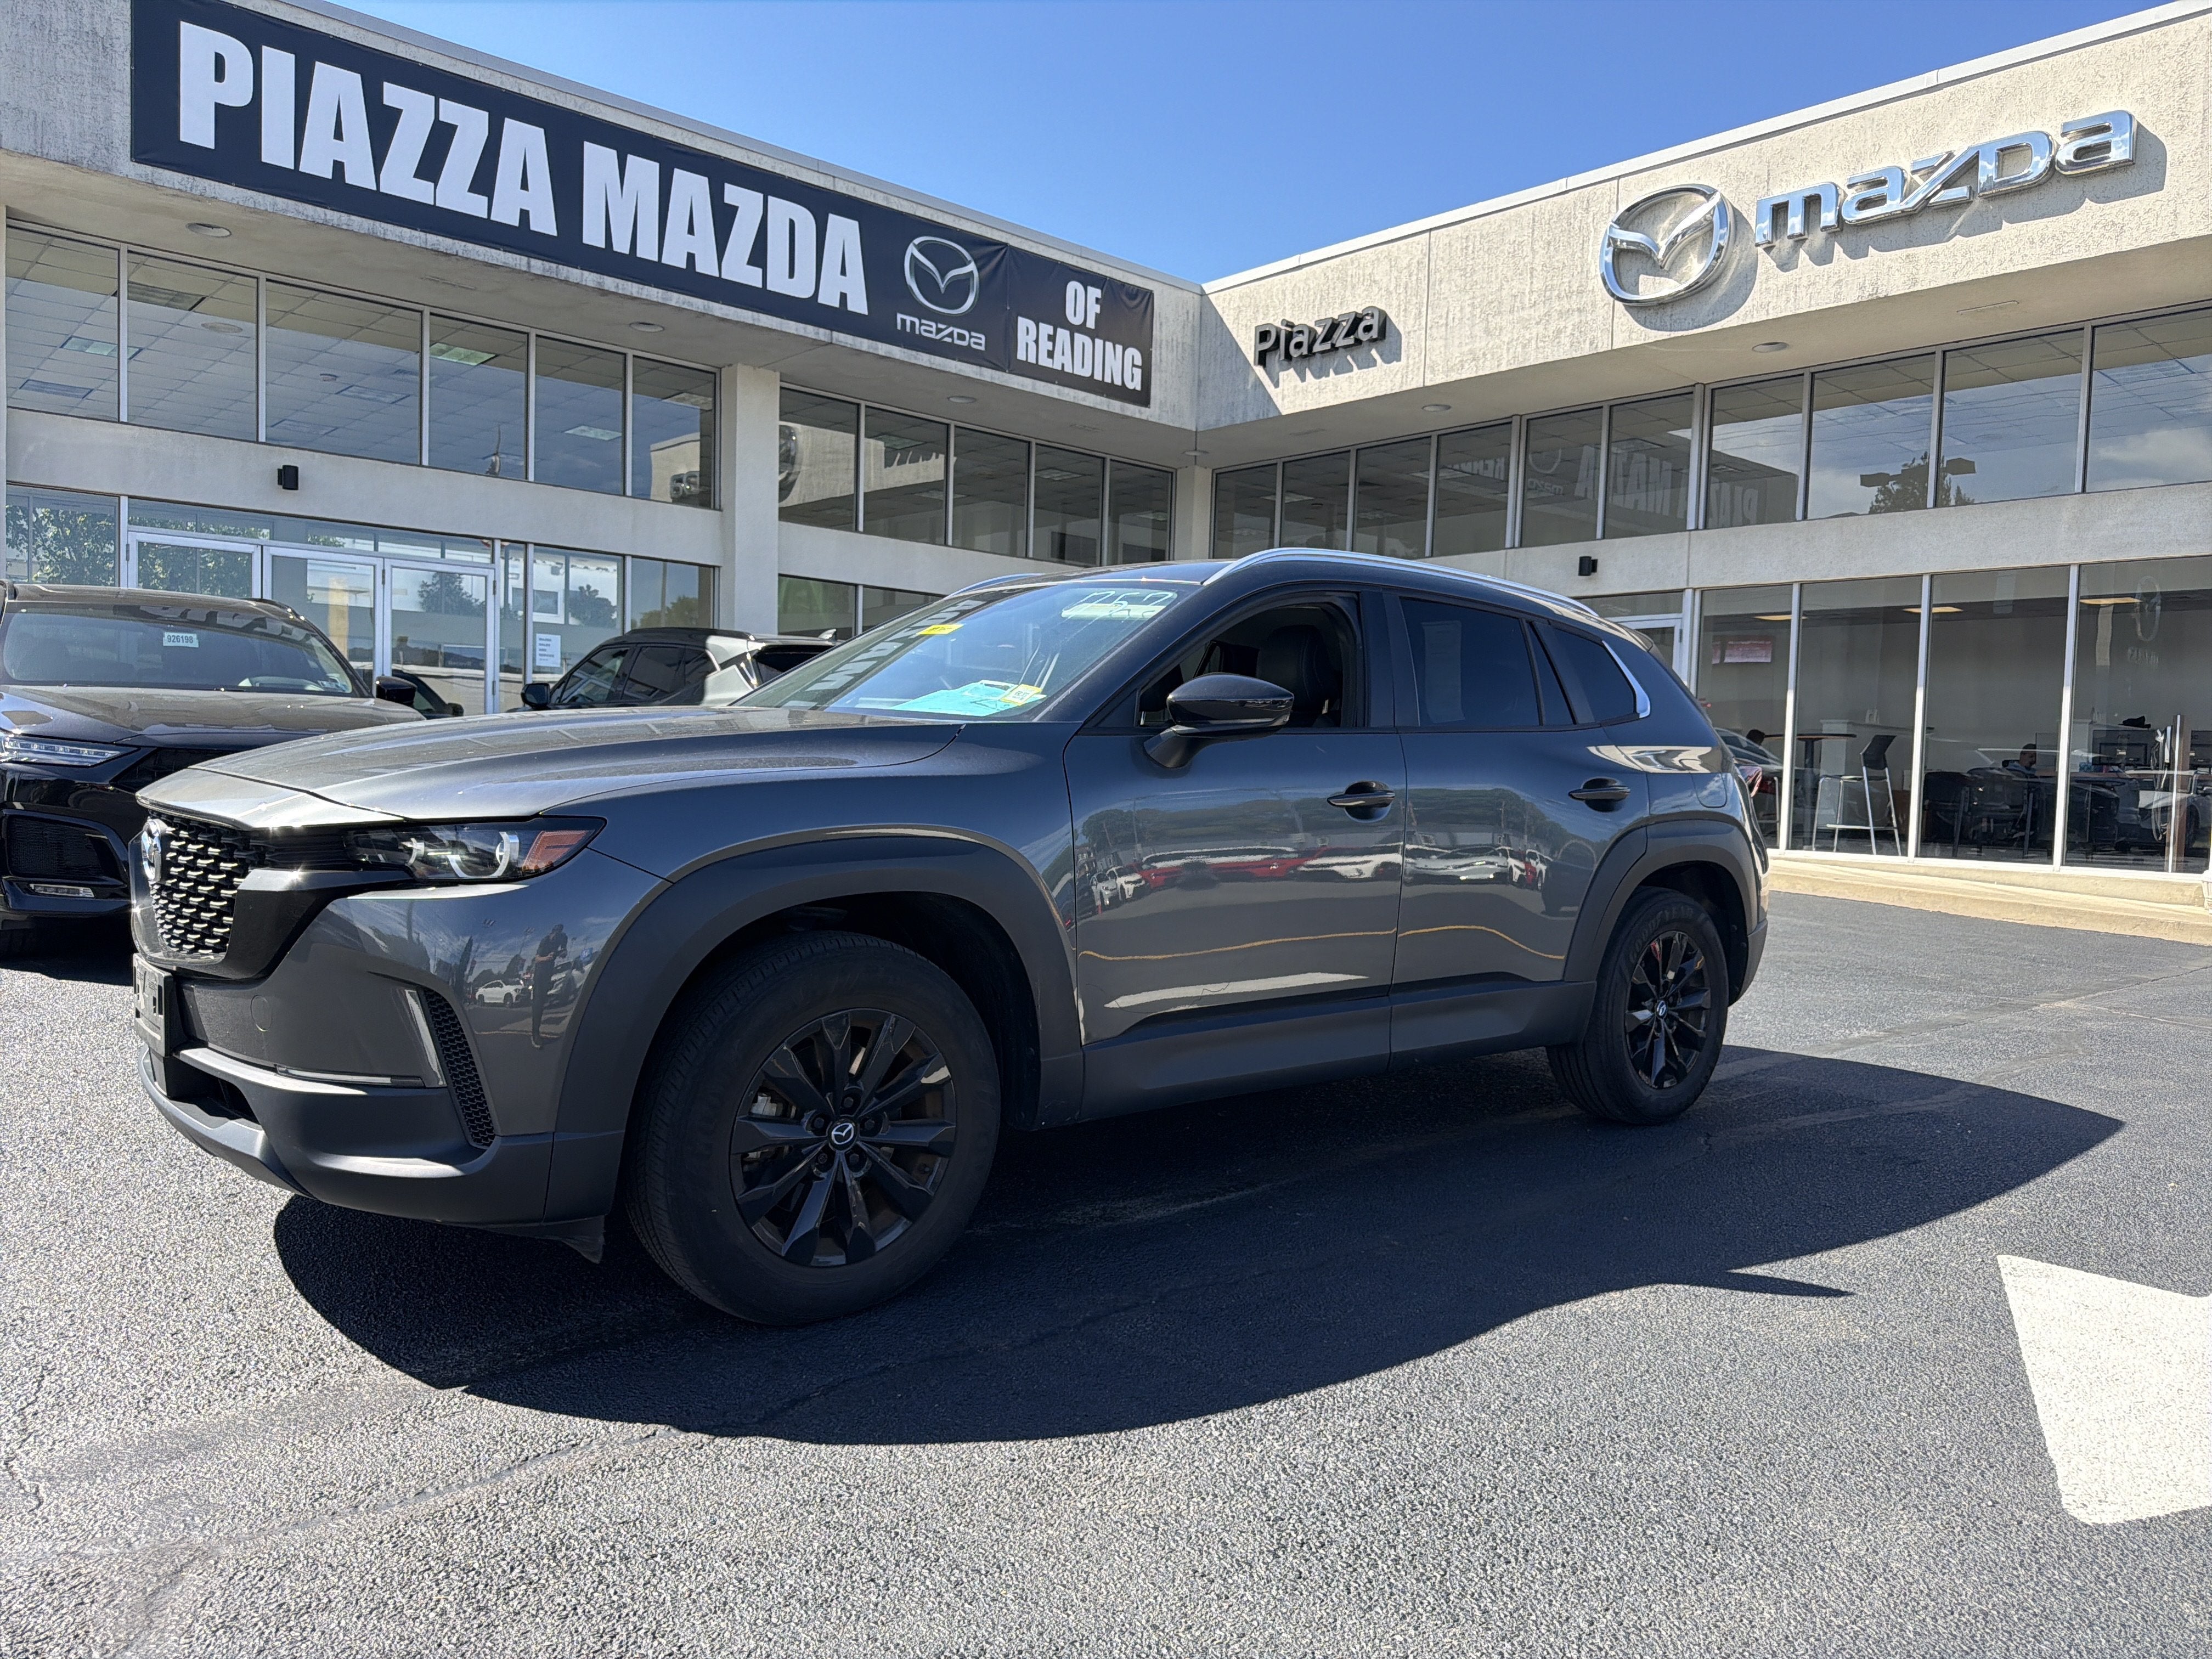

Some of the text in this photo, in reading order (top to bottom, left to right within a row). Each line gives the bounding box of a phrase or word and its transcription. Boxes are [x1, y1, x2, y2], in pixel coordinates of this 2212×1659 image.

[180, 20, 868, 315] PIAZZA MAZDA
[1755, 109, 2137, 247] mazda
[896, 312, 986, 351] mazda
[1065, 280, 1102, 329] OF
[1017, 315, 1142, 391] READING
[1253, 306, 1387, 368] Piazza
[167, 634, 194, 644] 926198
